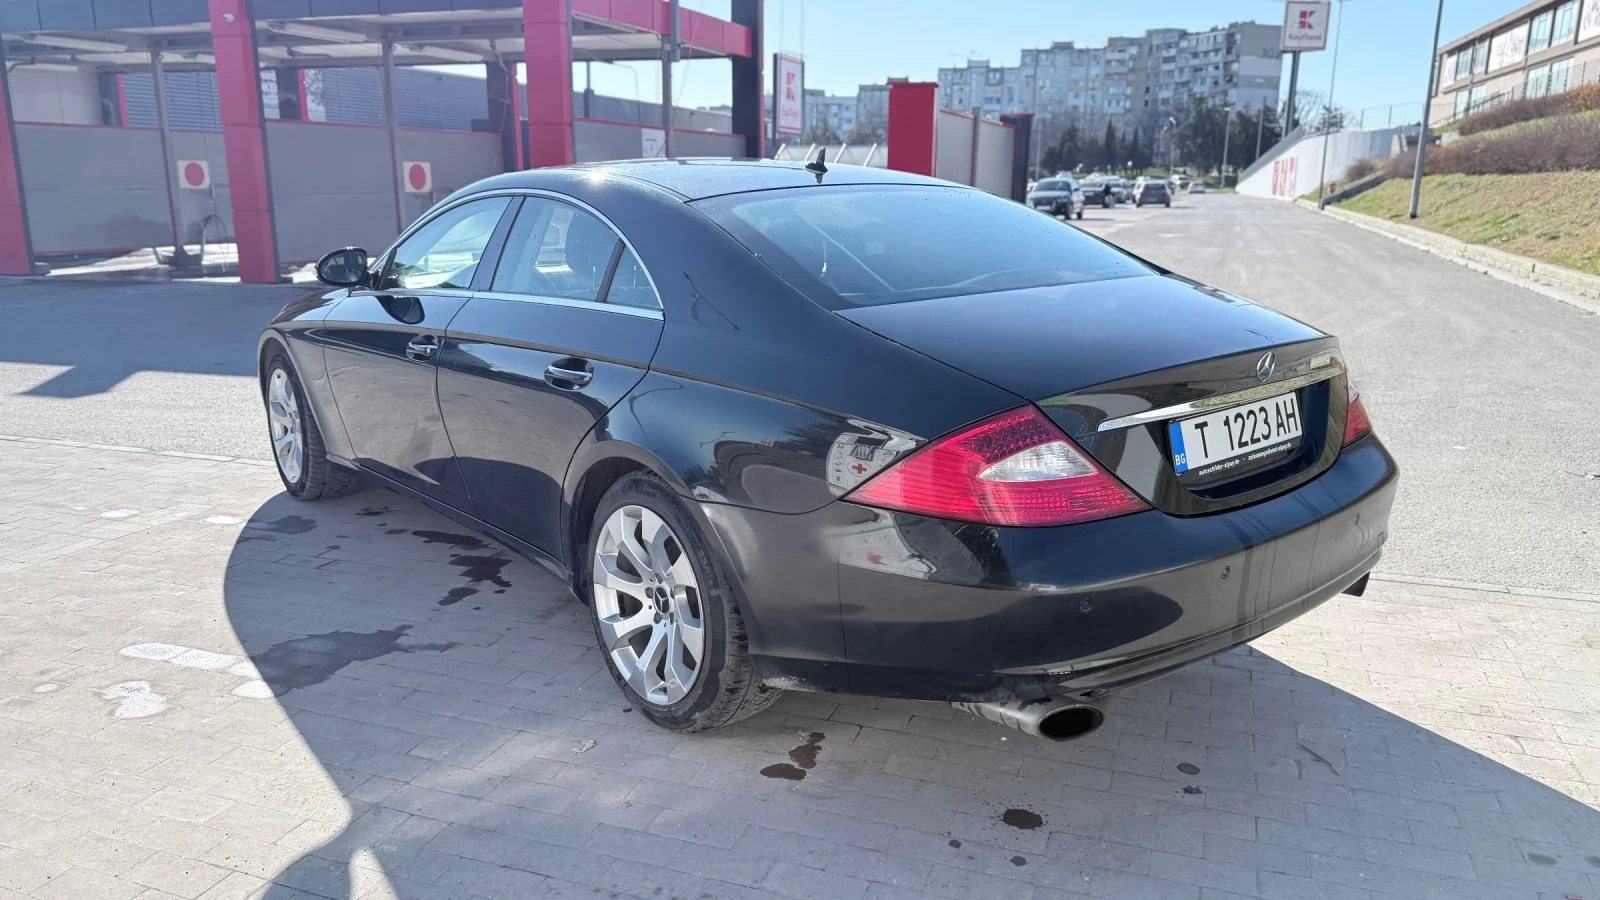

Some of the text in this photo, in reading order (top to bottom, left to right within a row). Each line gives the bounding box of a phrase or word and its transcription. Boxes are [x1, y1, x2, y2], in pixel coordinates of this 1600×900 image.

[1299, 10, 1316, 29] K
[787, 72, 796, 102] K
[1194, 398, 1298, 459] T 1223 AH
[1175, 454, 1187, 466] BG
